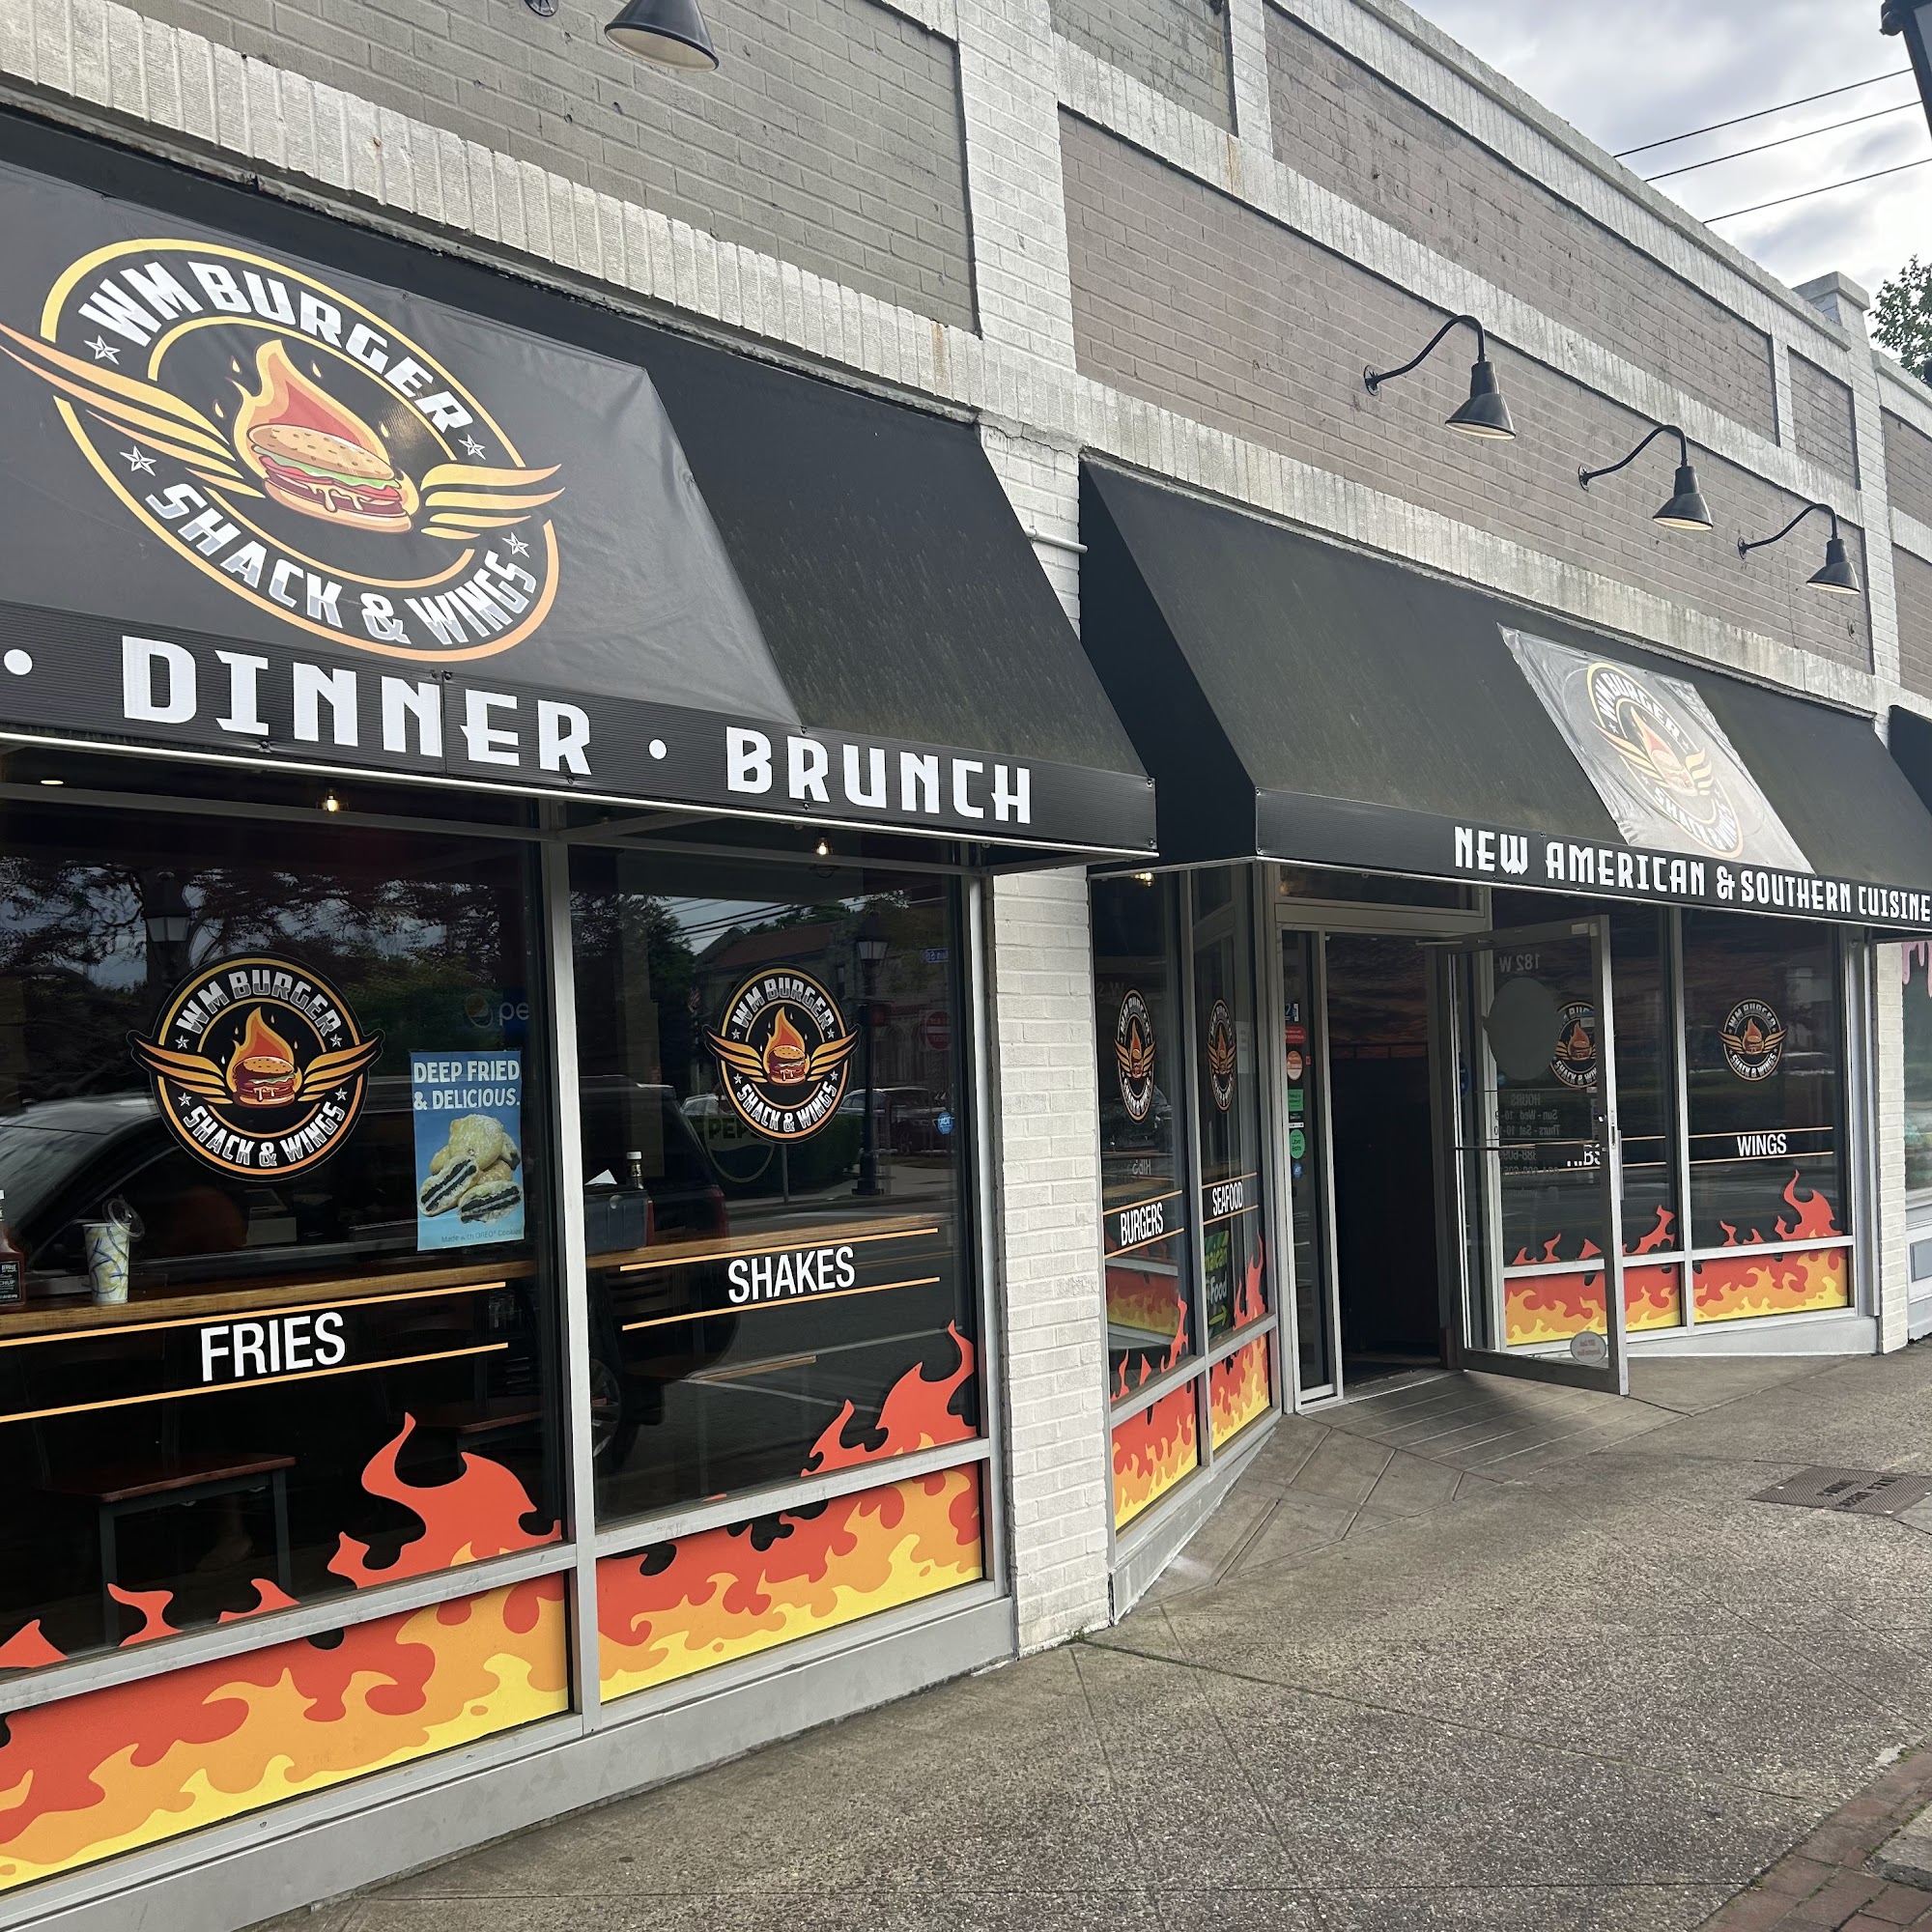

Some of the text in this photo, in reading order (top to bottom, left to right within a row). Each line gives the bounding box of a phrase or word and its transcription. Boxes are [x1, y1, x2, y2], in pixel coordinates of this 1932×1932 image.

[78, 261, 474, 433] WM BURGER
[146, 482, 537, 646] SHACK & WINGS
[121, 635, 1032, 825] DINNER BRUNCH
[1600, 672, 1682, 742] BURGER
[1653, 786, 1714, 847] SHACK
[1453, 825, 1932, 923] NEW AMERICAN & SOUTHERN CUISINE
[175, 969, 342, 1037] WM BURGER
[731, 977, 836, 1031] WM BURGER
[412, 1060, 521, 1083] DEEP FRIED
[412, 1087, 521, 1111] & DELICIOUS.
[182, 1100, 346, 1167] SHACK & WINGS
[708, 1117, 762, 1139] PEP
[736, 1080, 838, 1133] SHACK & WINGS
[1736, 1132, 1787, 1157] WINGS
[1120, 1201, 1164, 1247] BURGERS
[1211, 1180, 1244, 1217] SEAFOOD
[727, 1245, 856, 1304] SHAKES
[1209, 1270, 1228, 1305] Food
[200, 1311, 346, 1382] FRIES
